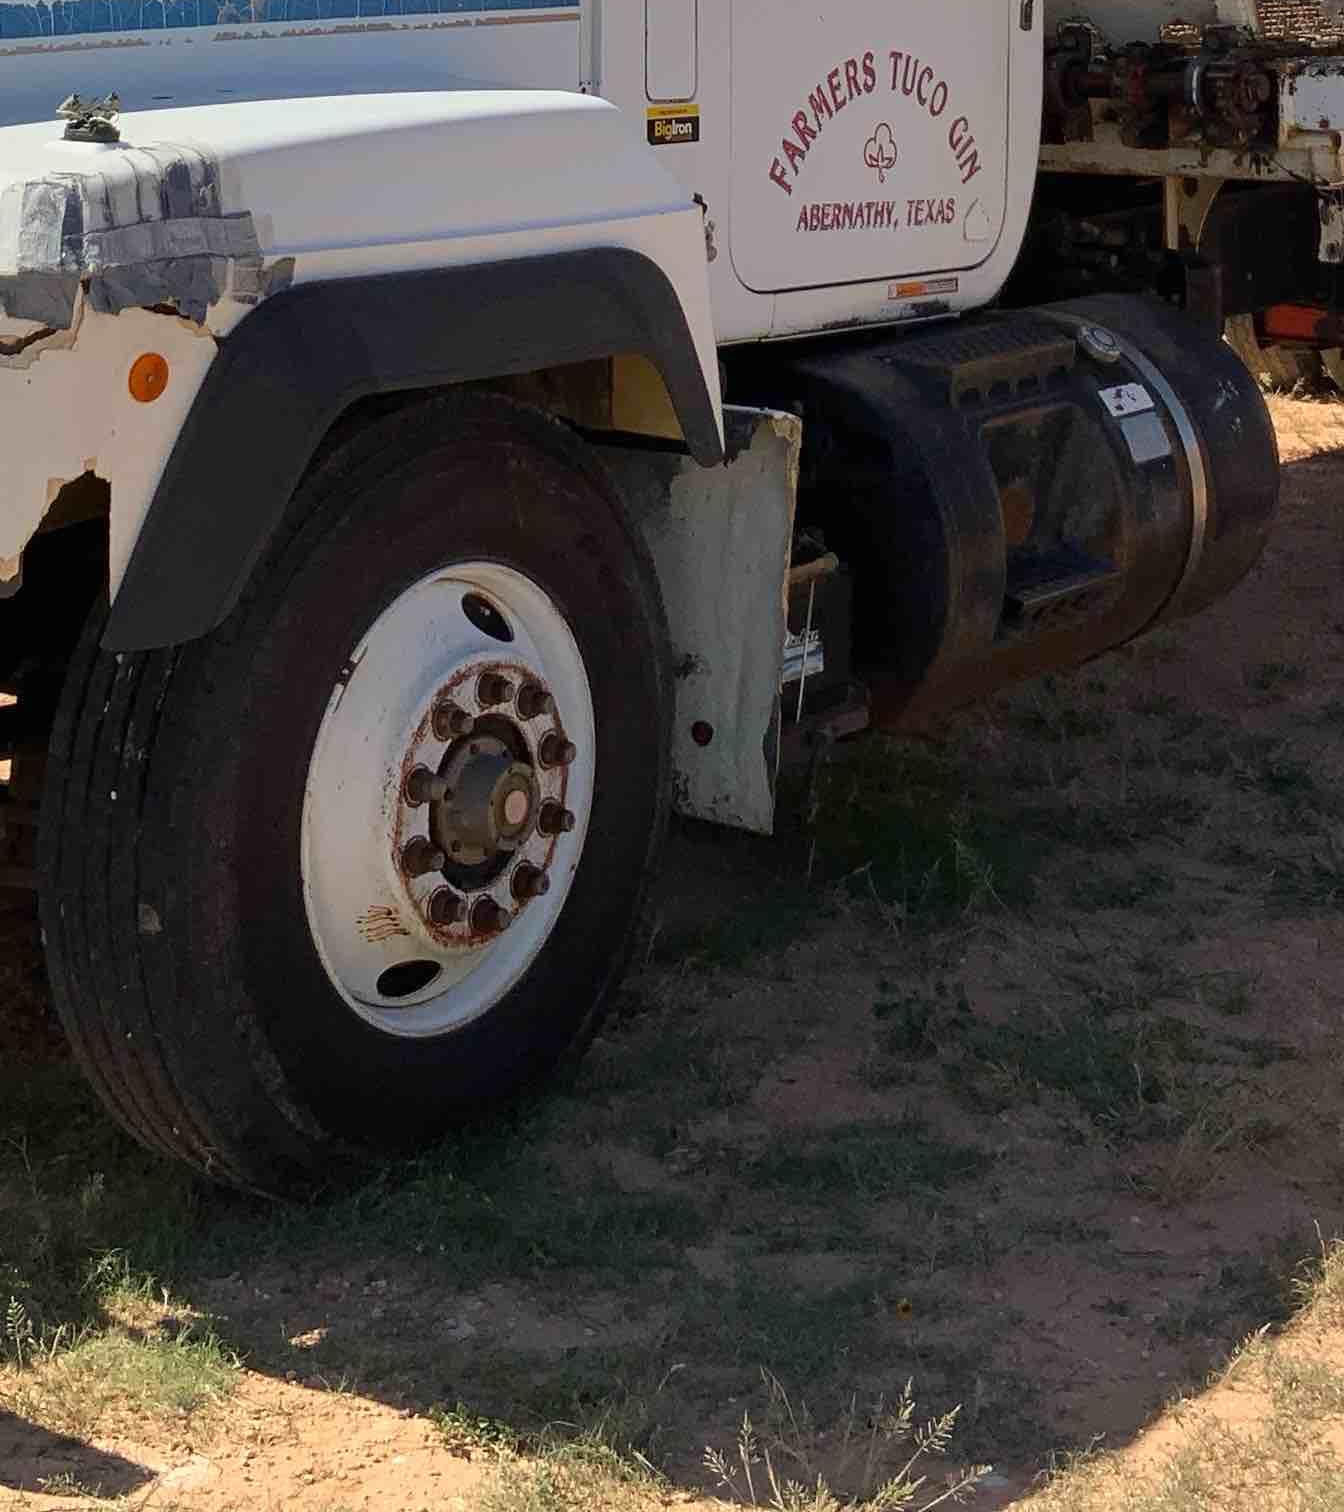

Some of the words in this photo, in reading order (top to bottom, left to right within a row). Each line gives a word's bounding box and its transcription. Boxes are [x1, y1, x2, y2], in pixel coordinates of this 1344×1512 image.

[654, 119, 693, 140] BigIron
[769, 51, 876, 196] FARMERS
[889, 51, 948, 117] TUCO
[948, 116, 982, 185] GIN
[796, 201, 899, 233] ABERNATHY,
[906, 198, 956, 227] TEXAS
